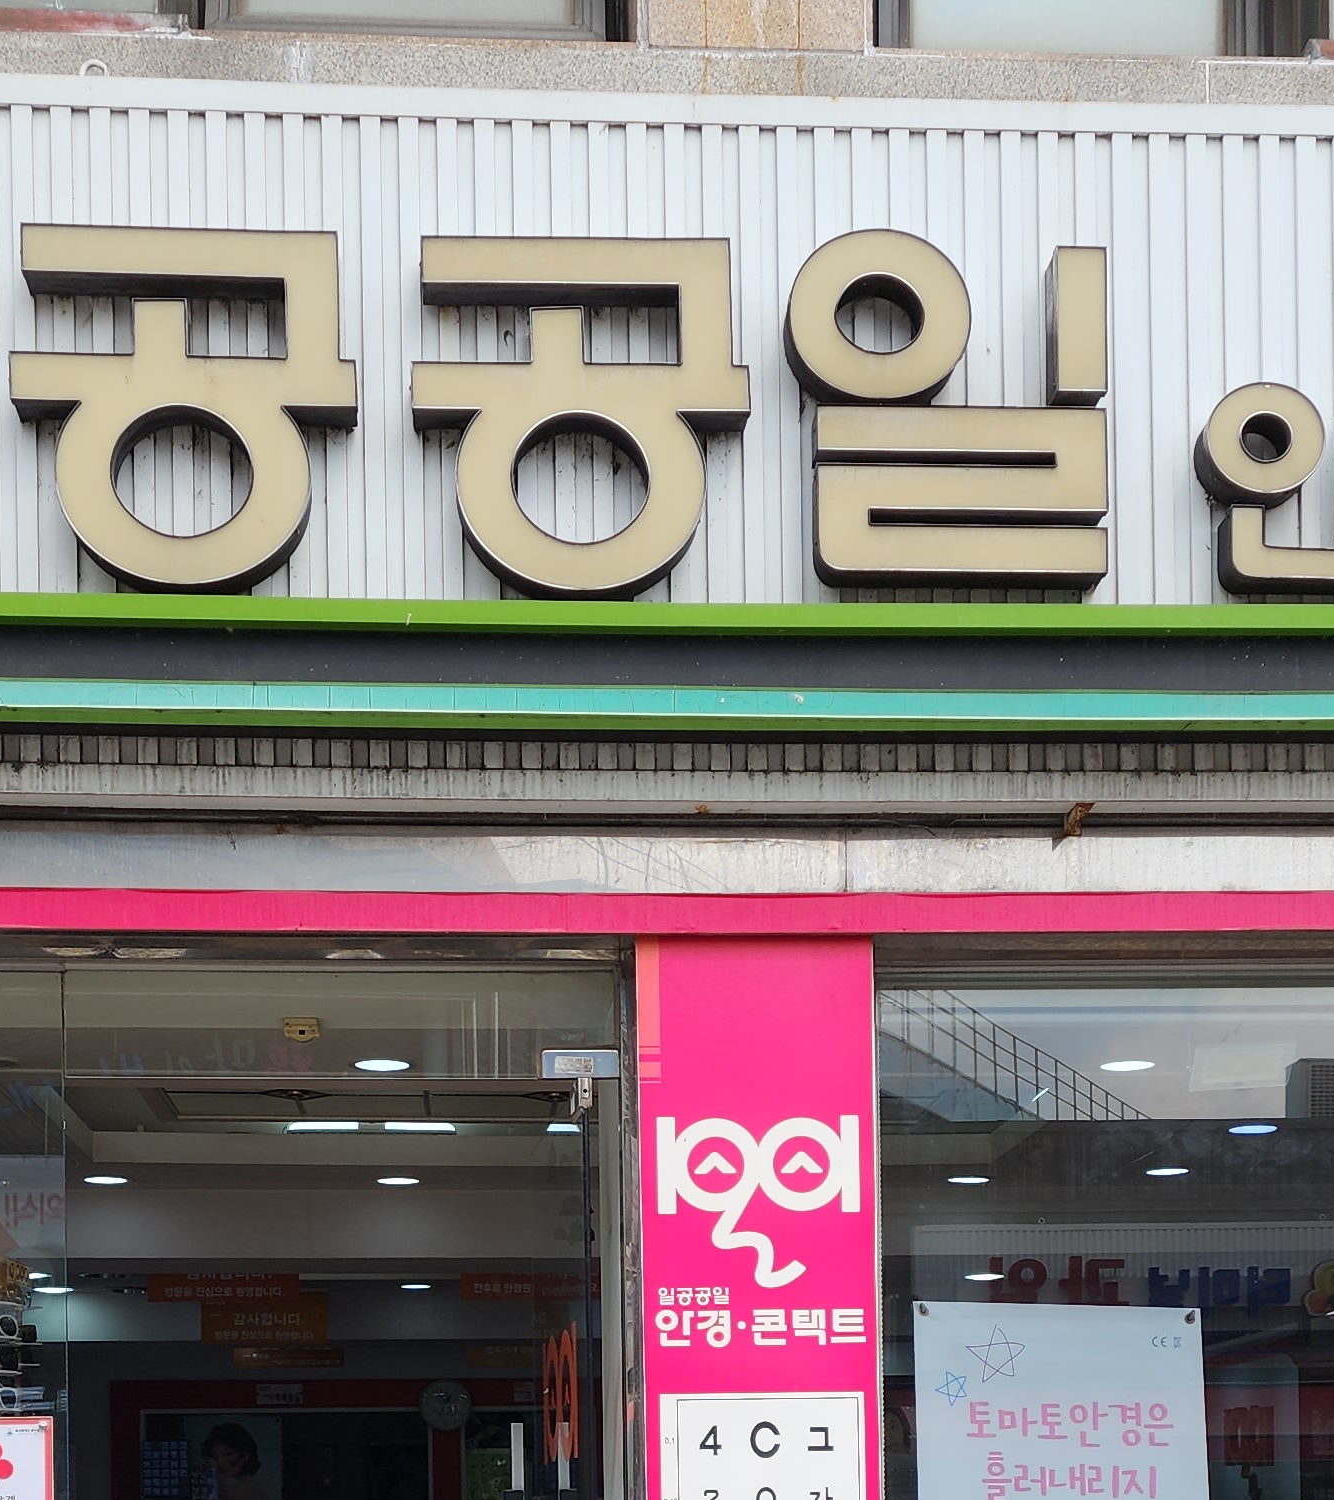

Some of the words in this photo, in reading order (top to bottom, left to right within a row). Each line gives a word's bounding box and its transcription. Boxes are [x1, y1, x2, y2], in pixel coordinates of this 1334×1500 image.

[658, 1287, 729, 1306] 일공공일
[967, 1401, 1174, 1448] 토마토안경은
[699, 1425, 722, 1456] 4
